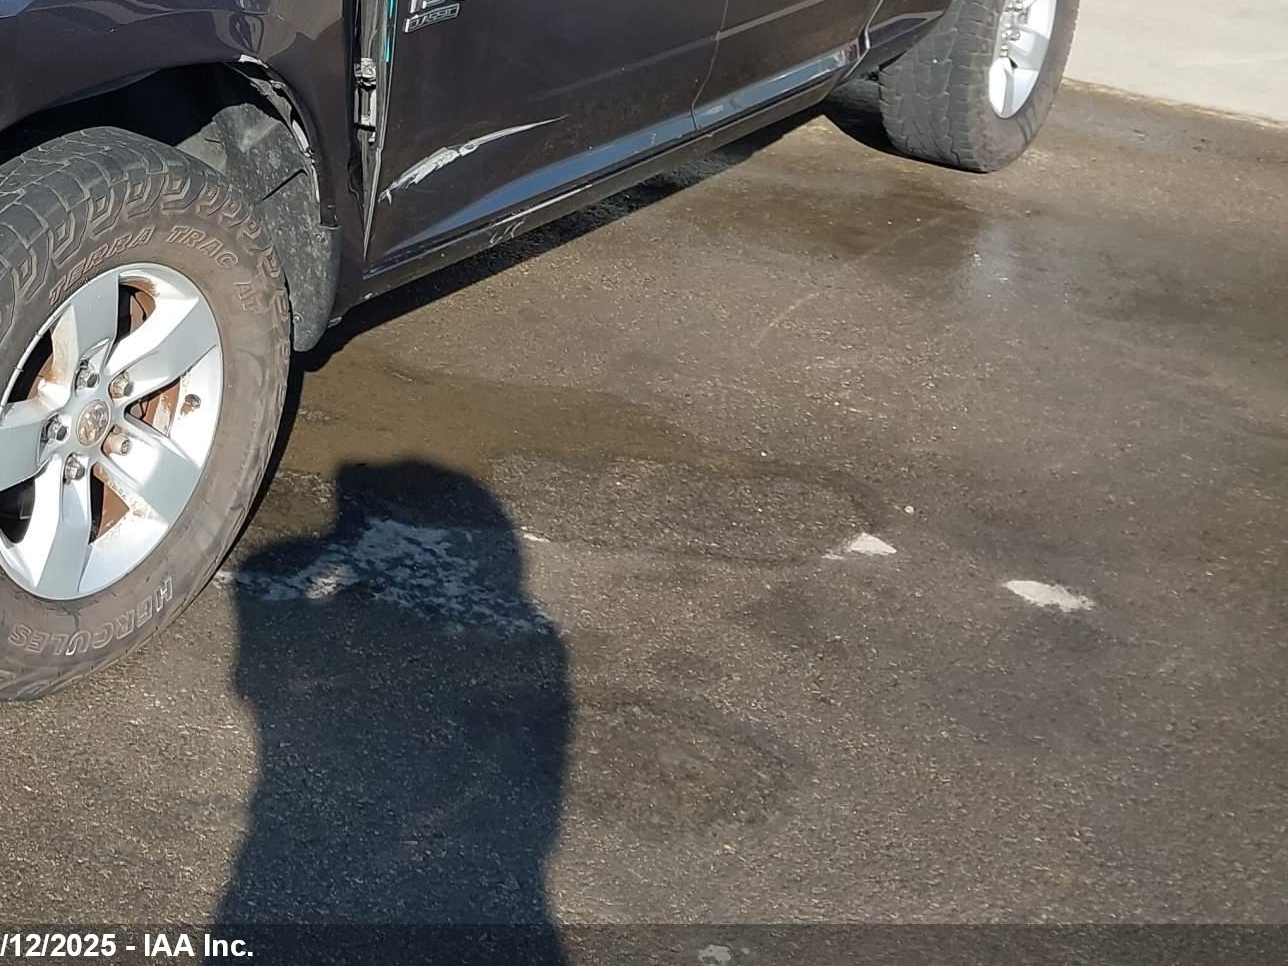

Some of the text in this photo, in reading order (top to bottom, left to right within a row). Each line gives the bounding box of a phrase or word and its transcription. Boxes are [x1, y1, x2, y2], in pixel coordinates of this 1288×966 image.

[49, 225, 156, 306] TERRA
[166, 224, 239, 269] TRAC
[8, 576, 173, 656] HERCULES
